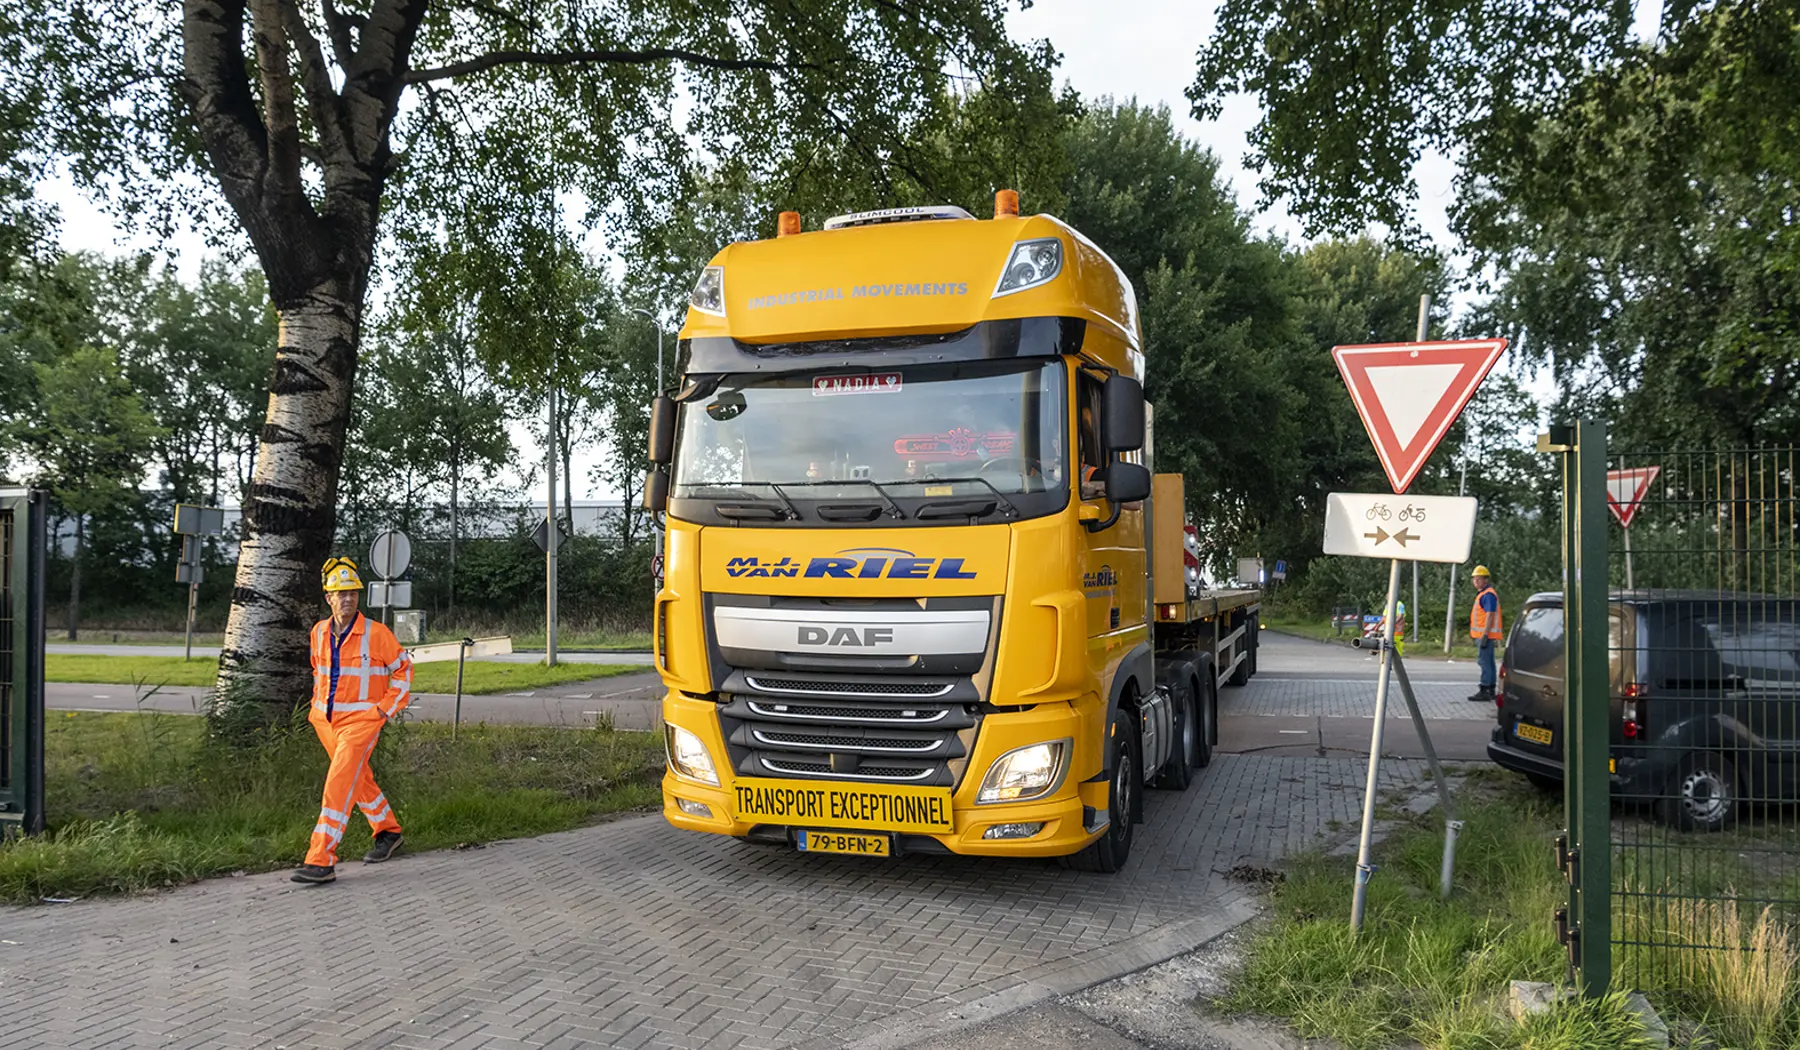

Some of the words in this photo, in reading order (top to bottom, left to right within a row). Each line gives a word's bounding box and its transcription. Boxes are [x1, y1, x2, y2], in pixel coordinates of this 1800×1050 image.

[747, 287, 845, 311] INDUSTRIAL
[851, 282, 969, 298] MOVEMENTS
[832, 377, 881, 393] NADIA
[725, 567, 801, 578] VAN
[803, 557, 978, 580] RIEL
[1096, 571, 1118, 587] RIEL
[797, 626, 894, 647] DAF
[734, 786, 825, 818] TRANSPORT
[830, 791, 950, 825] EXCEPTIONNEL
[811, 834, 883, 854] 79-BFN-2
